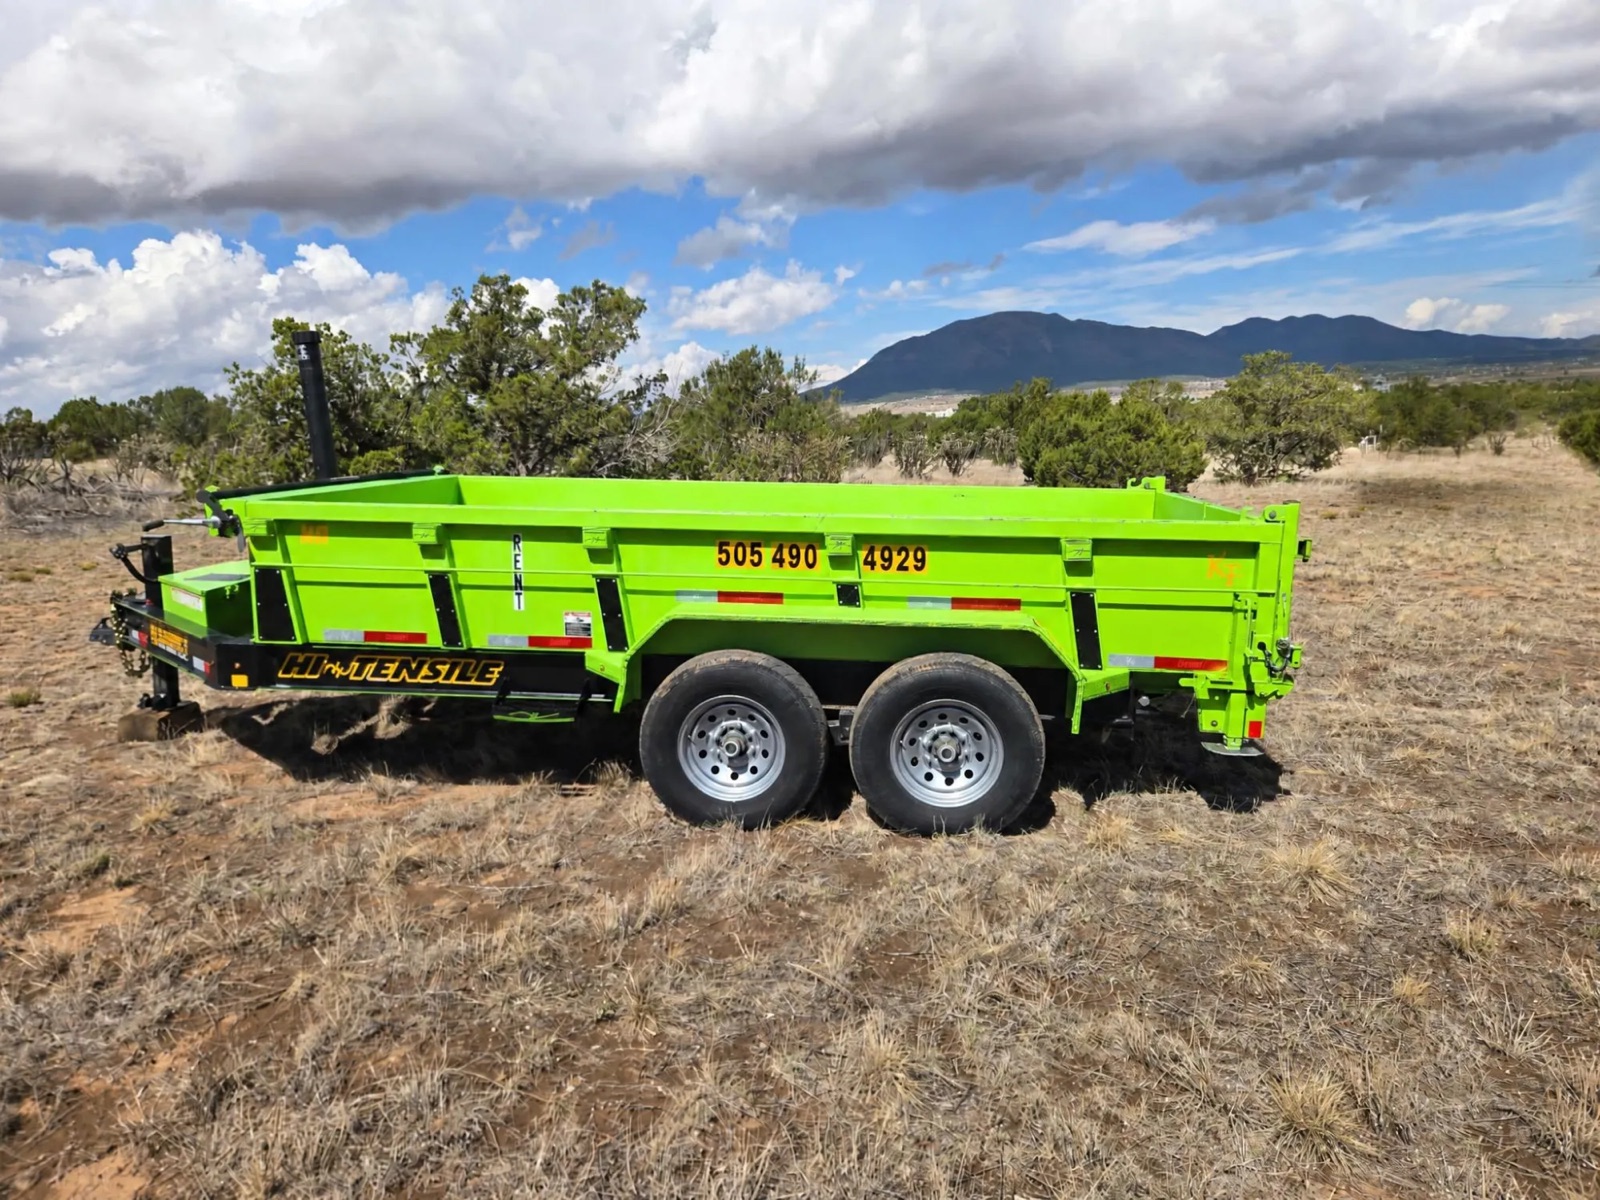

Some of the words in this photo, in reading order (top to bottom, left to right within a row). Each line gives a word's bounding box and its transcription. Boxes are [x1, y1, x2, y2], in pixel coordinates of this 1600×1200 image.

[513, 533, 523, 610] RENT
[717, 540, 763, 567] 505
[772, 543, 818, 569] 490
[863, 545, 927, 571] 4929
[278, 653, 329, 678] HI
[350, 655, 504, 685] TENSILE
